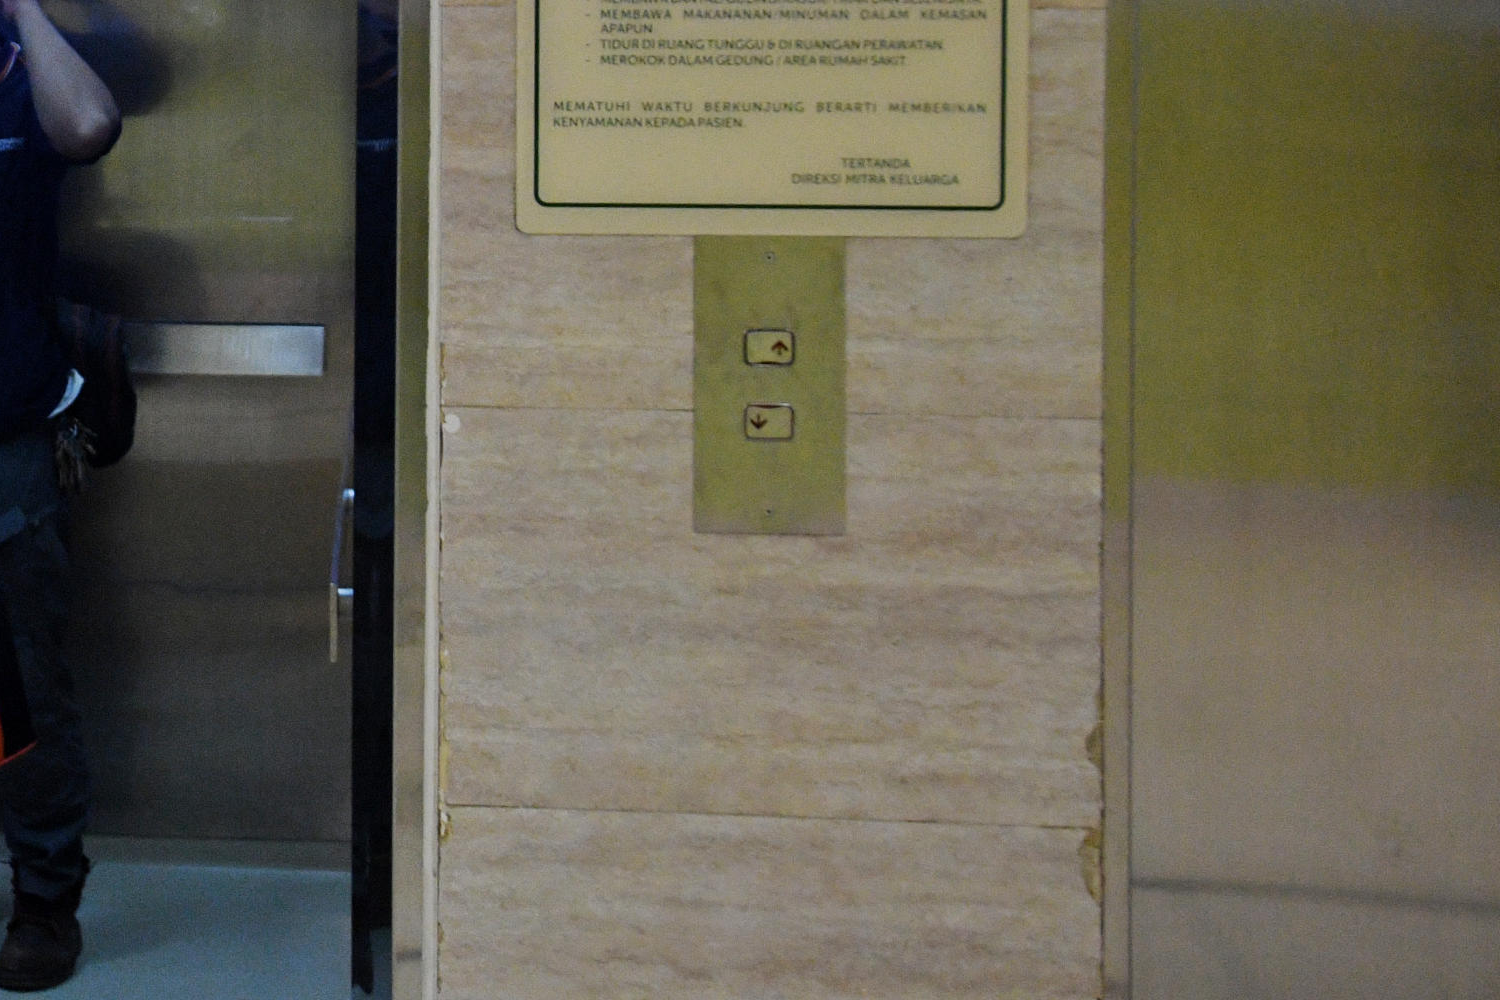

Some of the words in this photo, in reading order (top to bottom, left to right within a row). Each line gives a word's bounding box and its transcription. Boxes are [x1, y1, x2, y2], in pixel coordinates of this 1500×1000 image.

[601, 9, 672, 20] MEMBAWA
[859, 8, 909, 20] DALAM
[920, 8, 987, 20] KEMASAN
[601, 23, 653, 34] APAPUN
[601, 38, 639, 50] TIDUR
[642, 38, 655, 49] DI
[658, 38, 705, 50] RUANG
[707, 38, 764, 50] TUNGGU
[779, 38, 792, 50] DI
[795, 38, 860, 50] RUANGAN
[863, 38, 943, 50] PERAWATAN
[601, 54, 664, 66] MEROKOK
[668, 54, 713, 66] DALAM
[716, 55, 774, 66] GEDUNG
[784, 55, 816, 66] AREA
[819, 55, 868, 66] RUMAH
[553, 100, 631, 112] MEMATUHI
[641, 101, 693, 112] WAKTU
[704, 101, 804, 113] BERKUNJUNG
[816, 101, 877, 113] BERARTI
[888, 102, 987, 113] MEMBERIKAN
[553, 116, 642, 128] KENYAMANAN
[645, 116, 695, 128] KEPADA
[841, 157, 911, 168] TERTANDA
[791, 173, 841, 184] DIREKSI
[846, 173, 886, 184] MITRA
[889, 174, 959, 185] KELUARGA
